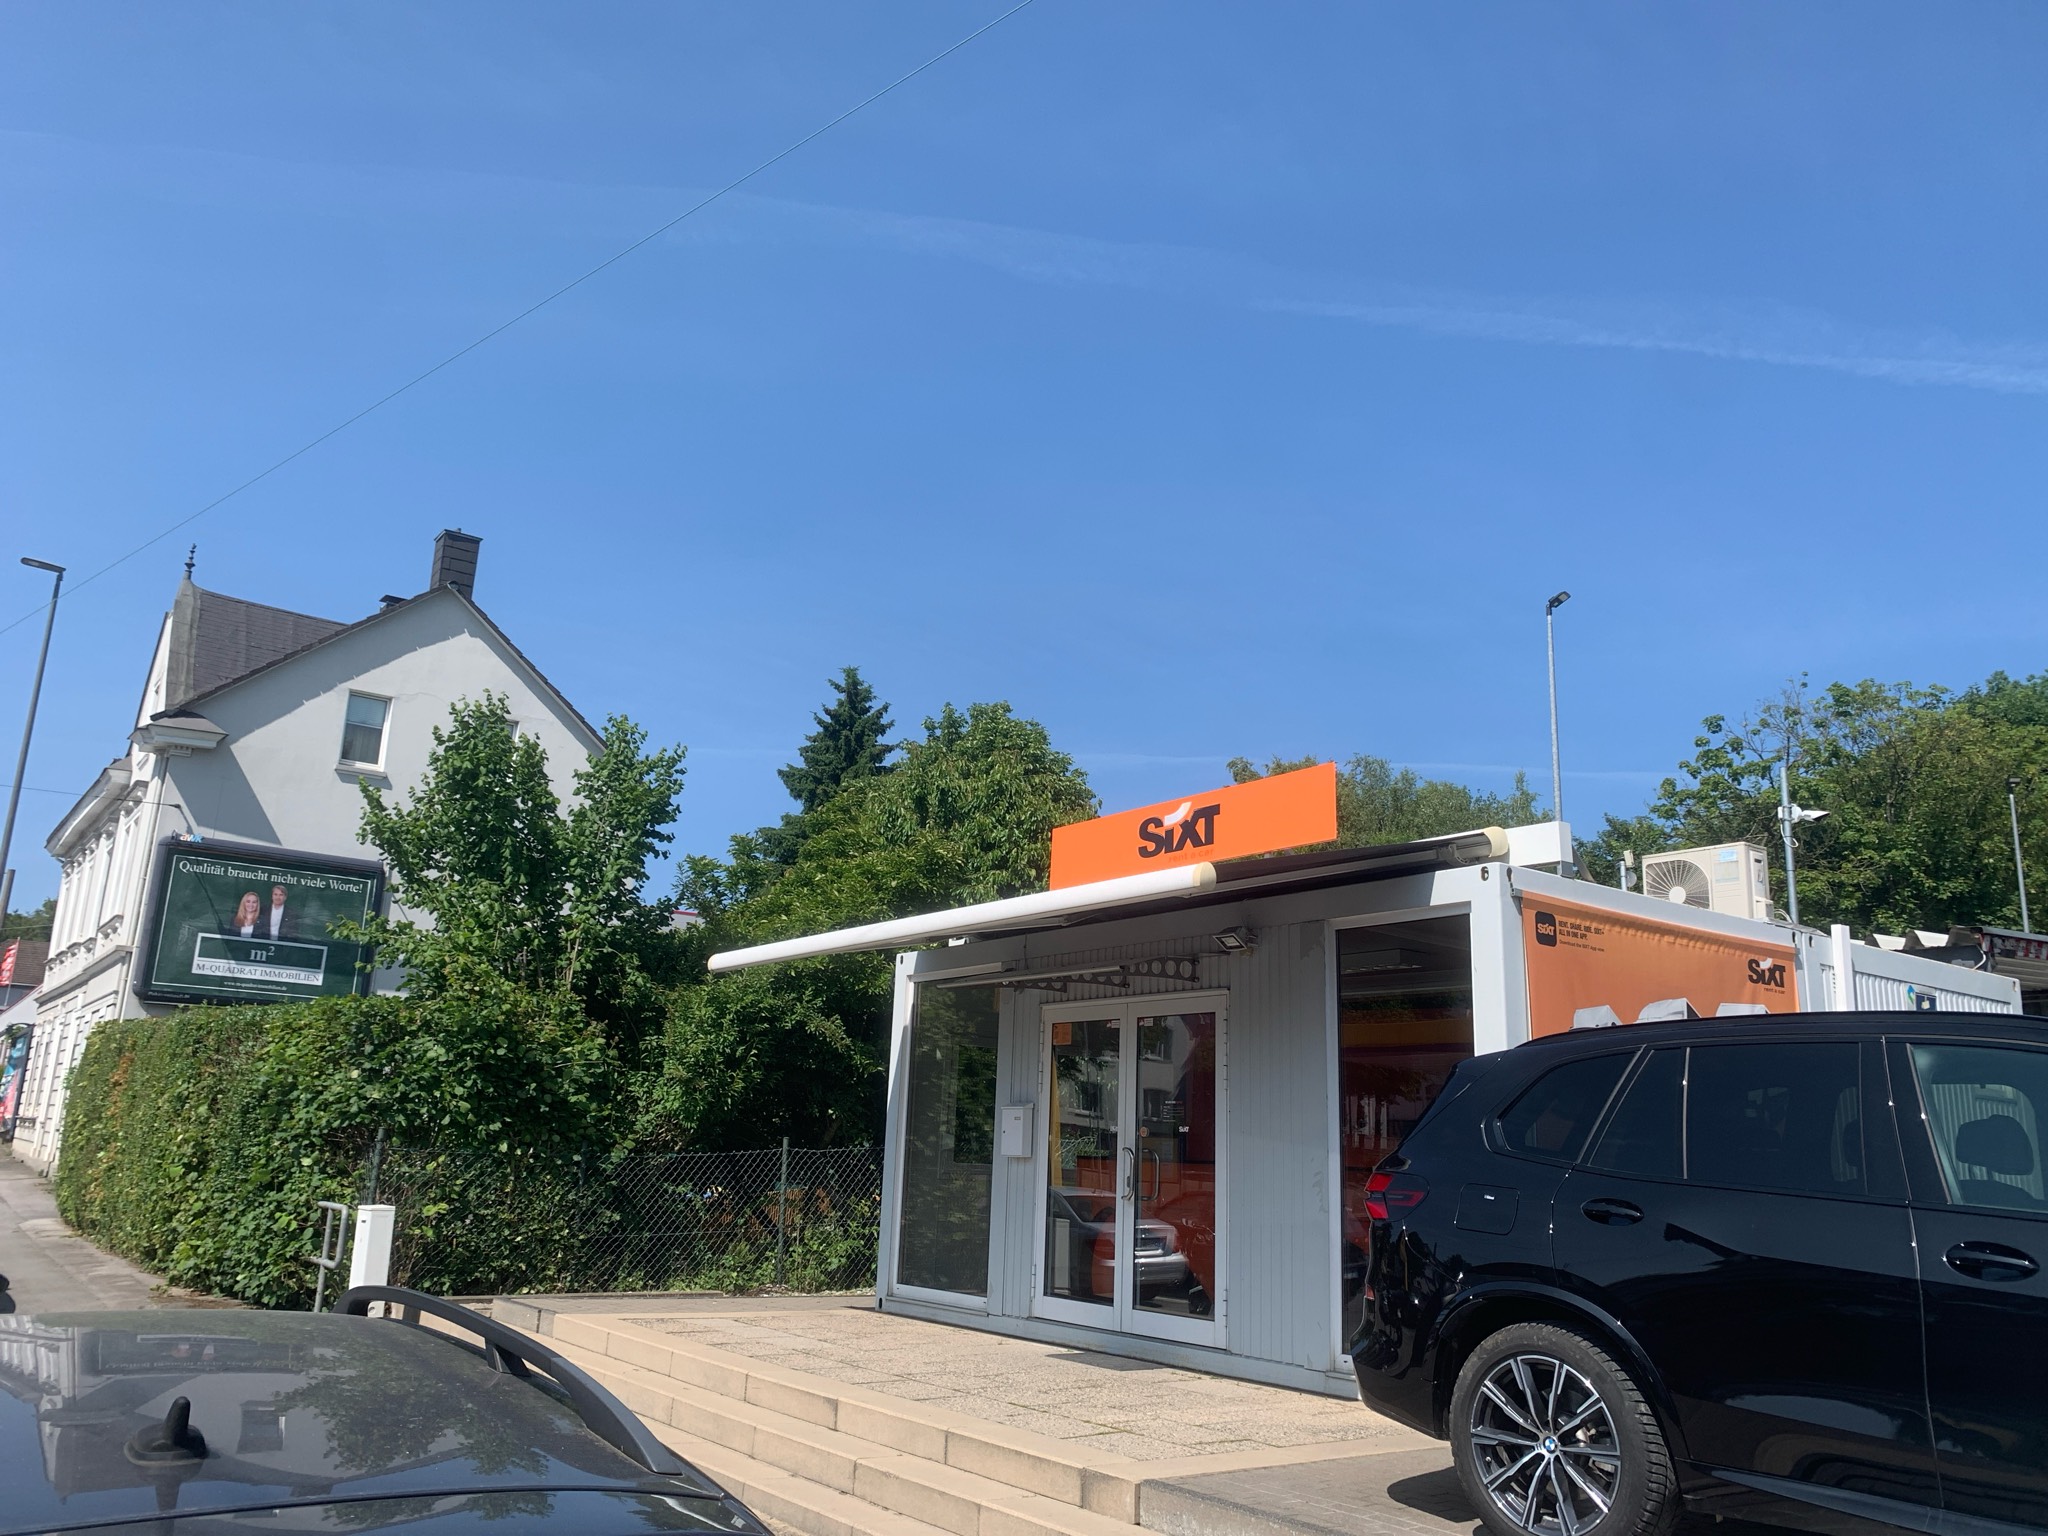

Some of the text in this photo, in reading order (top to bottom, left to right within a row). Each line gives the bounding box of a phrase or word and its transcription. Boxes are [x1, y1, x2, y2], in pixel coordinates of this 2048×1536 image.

[1138, 801, 1220, 858] SIXT
[1169, 853, 1188, 862] rent
[1198, 848, 1214, 857] car
[179, 860, 363, 893] Qualität braucht nicht viele Worte!
[1537, 923, 1555, 936] SIXT
[195, 963, 320, 982] M-QUADRAT IMMOBILIEN
[1747, 957, 1786, 988] SIXT
